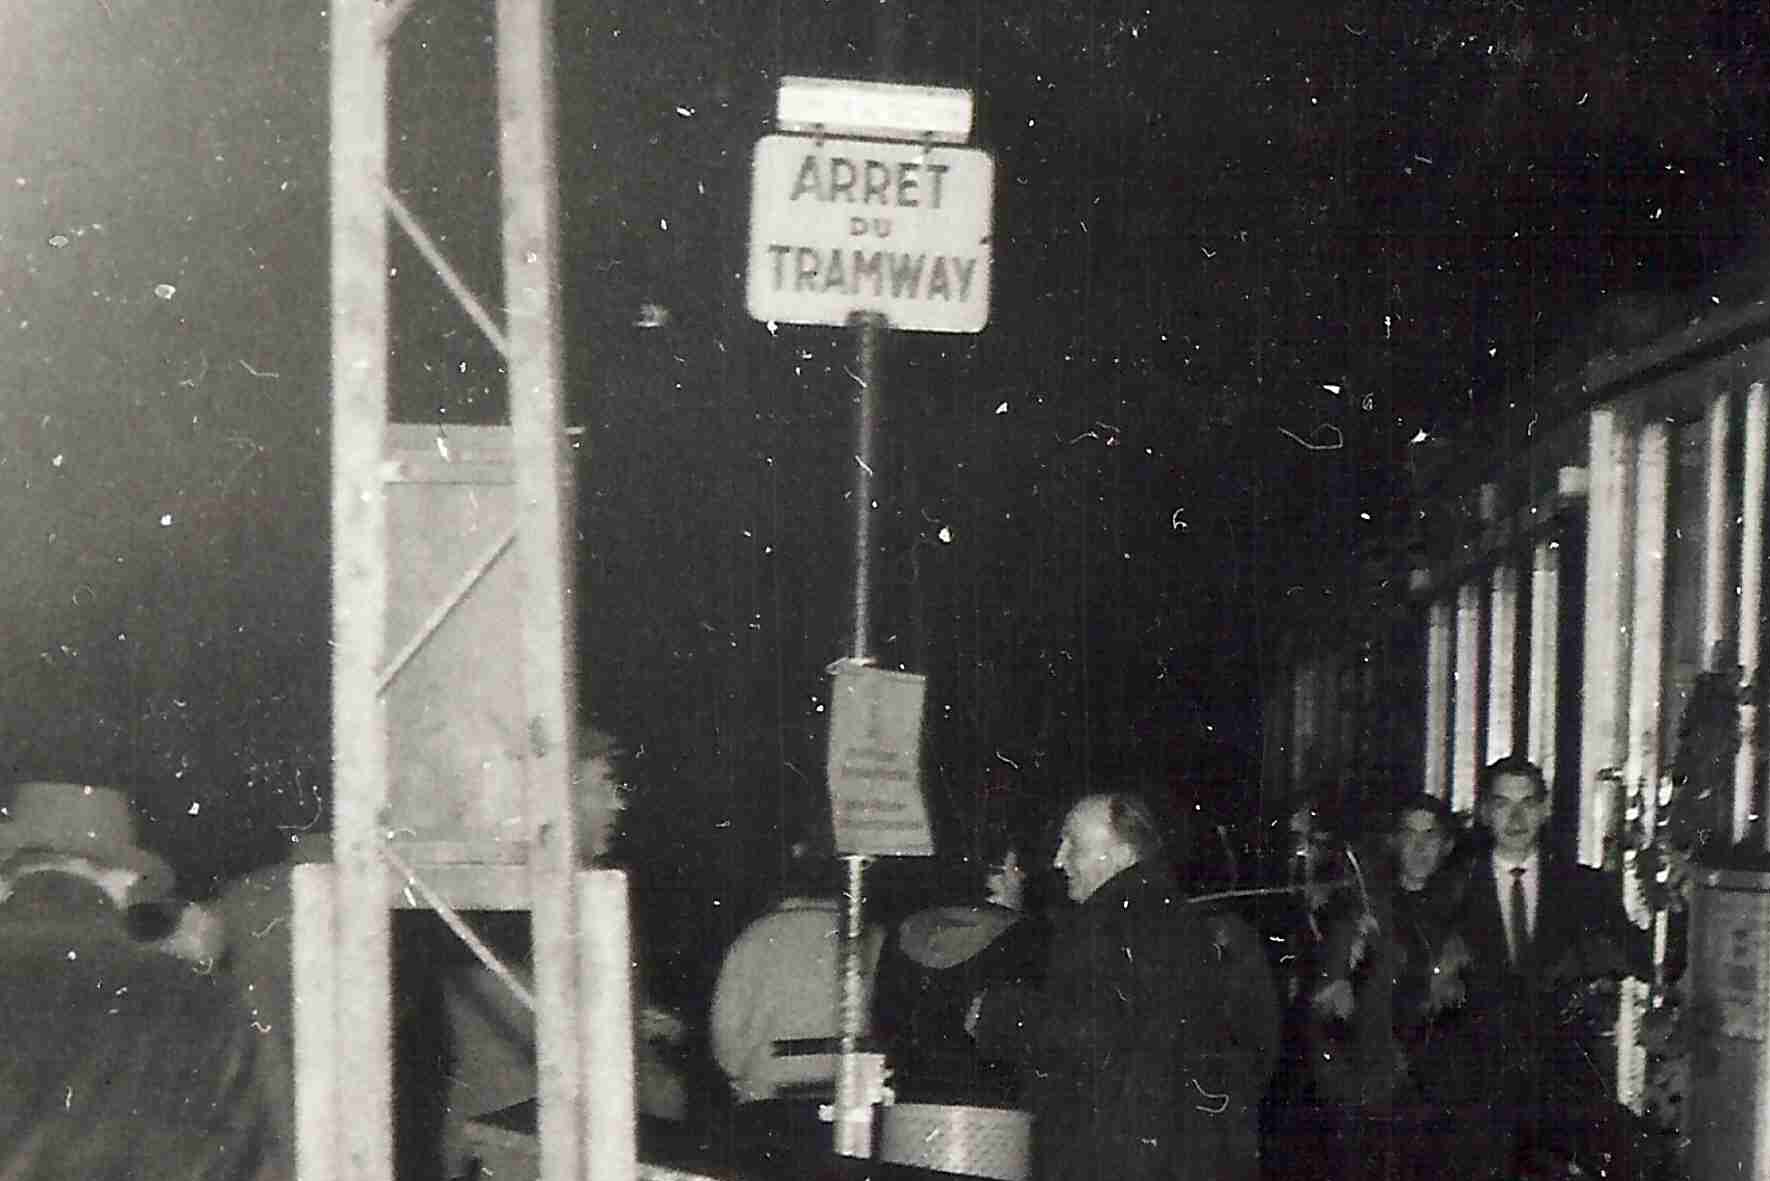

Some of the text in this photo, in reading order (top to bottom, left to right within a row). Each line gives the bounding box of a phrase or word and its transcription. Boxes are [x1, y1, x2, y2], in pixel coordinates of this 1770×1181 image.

[790, 155, 950, 209] ARRET
[849, 215, 893, 239] DU
[766, 245, 977, 302] TRAMWAY
